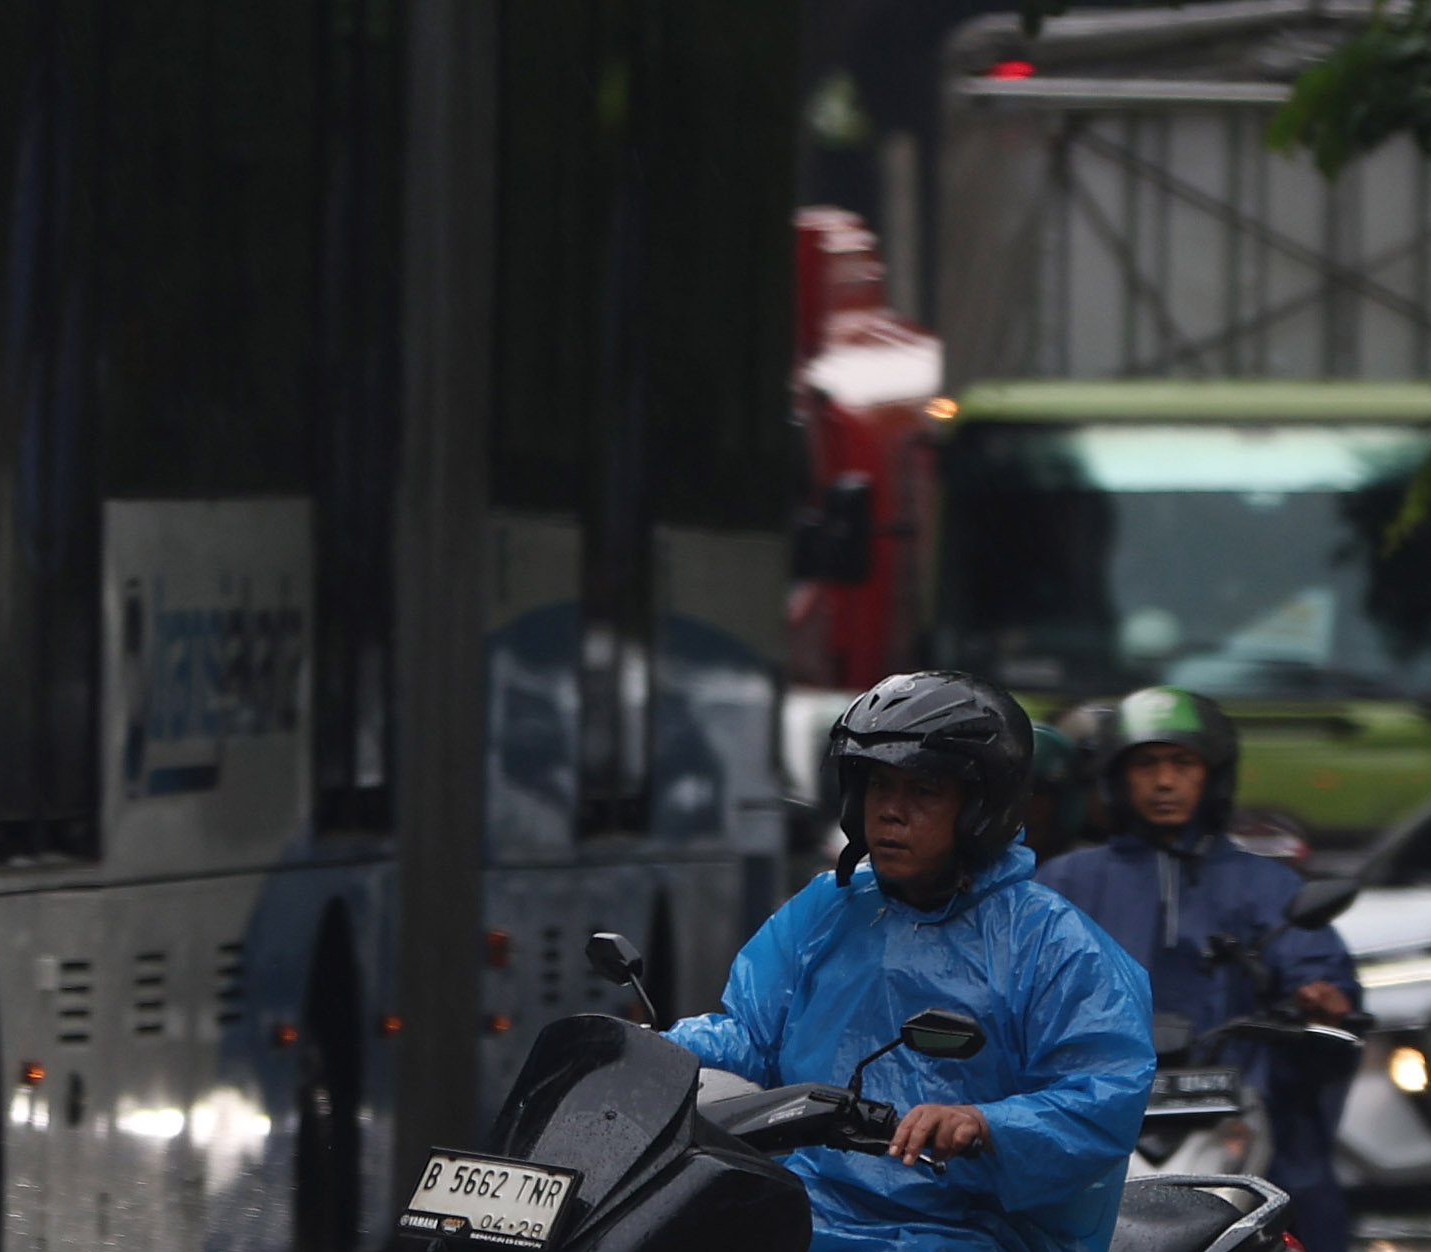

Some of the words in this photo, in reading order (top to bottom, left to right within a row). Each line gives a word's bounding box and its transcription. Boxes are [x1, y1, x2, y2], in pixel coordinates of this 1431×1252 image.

[424, 1162, 442, 1190] B
[450, 1166, 509, 1198] 5662
[516, 1175, 562, 1208] TNR
